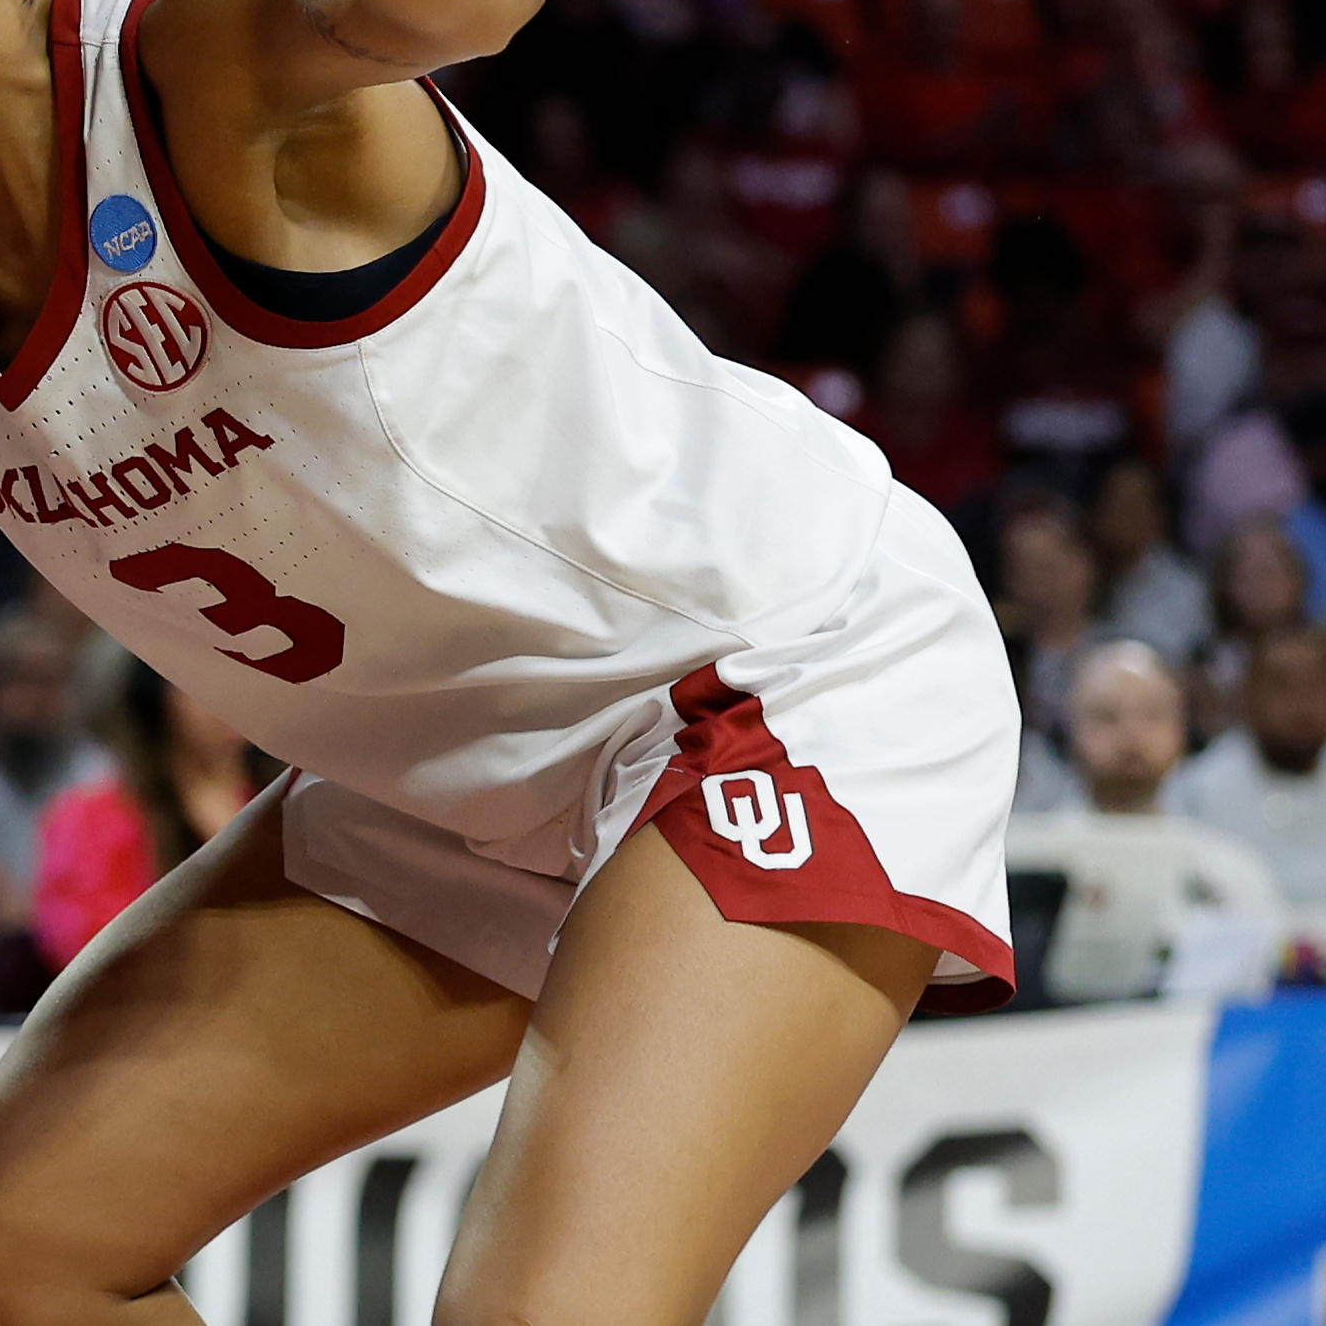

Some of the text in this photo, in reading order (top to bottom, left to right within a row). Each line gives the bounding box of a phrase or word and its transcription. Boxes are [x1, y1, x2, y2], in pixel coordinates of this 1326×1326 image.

[103, 220, 153, 260] NCAA
[107, 285, 202, 387] SEC
[109, 542, 346, 684] 3
[700, 768, 814, 870] OU
